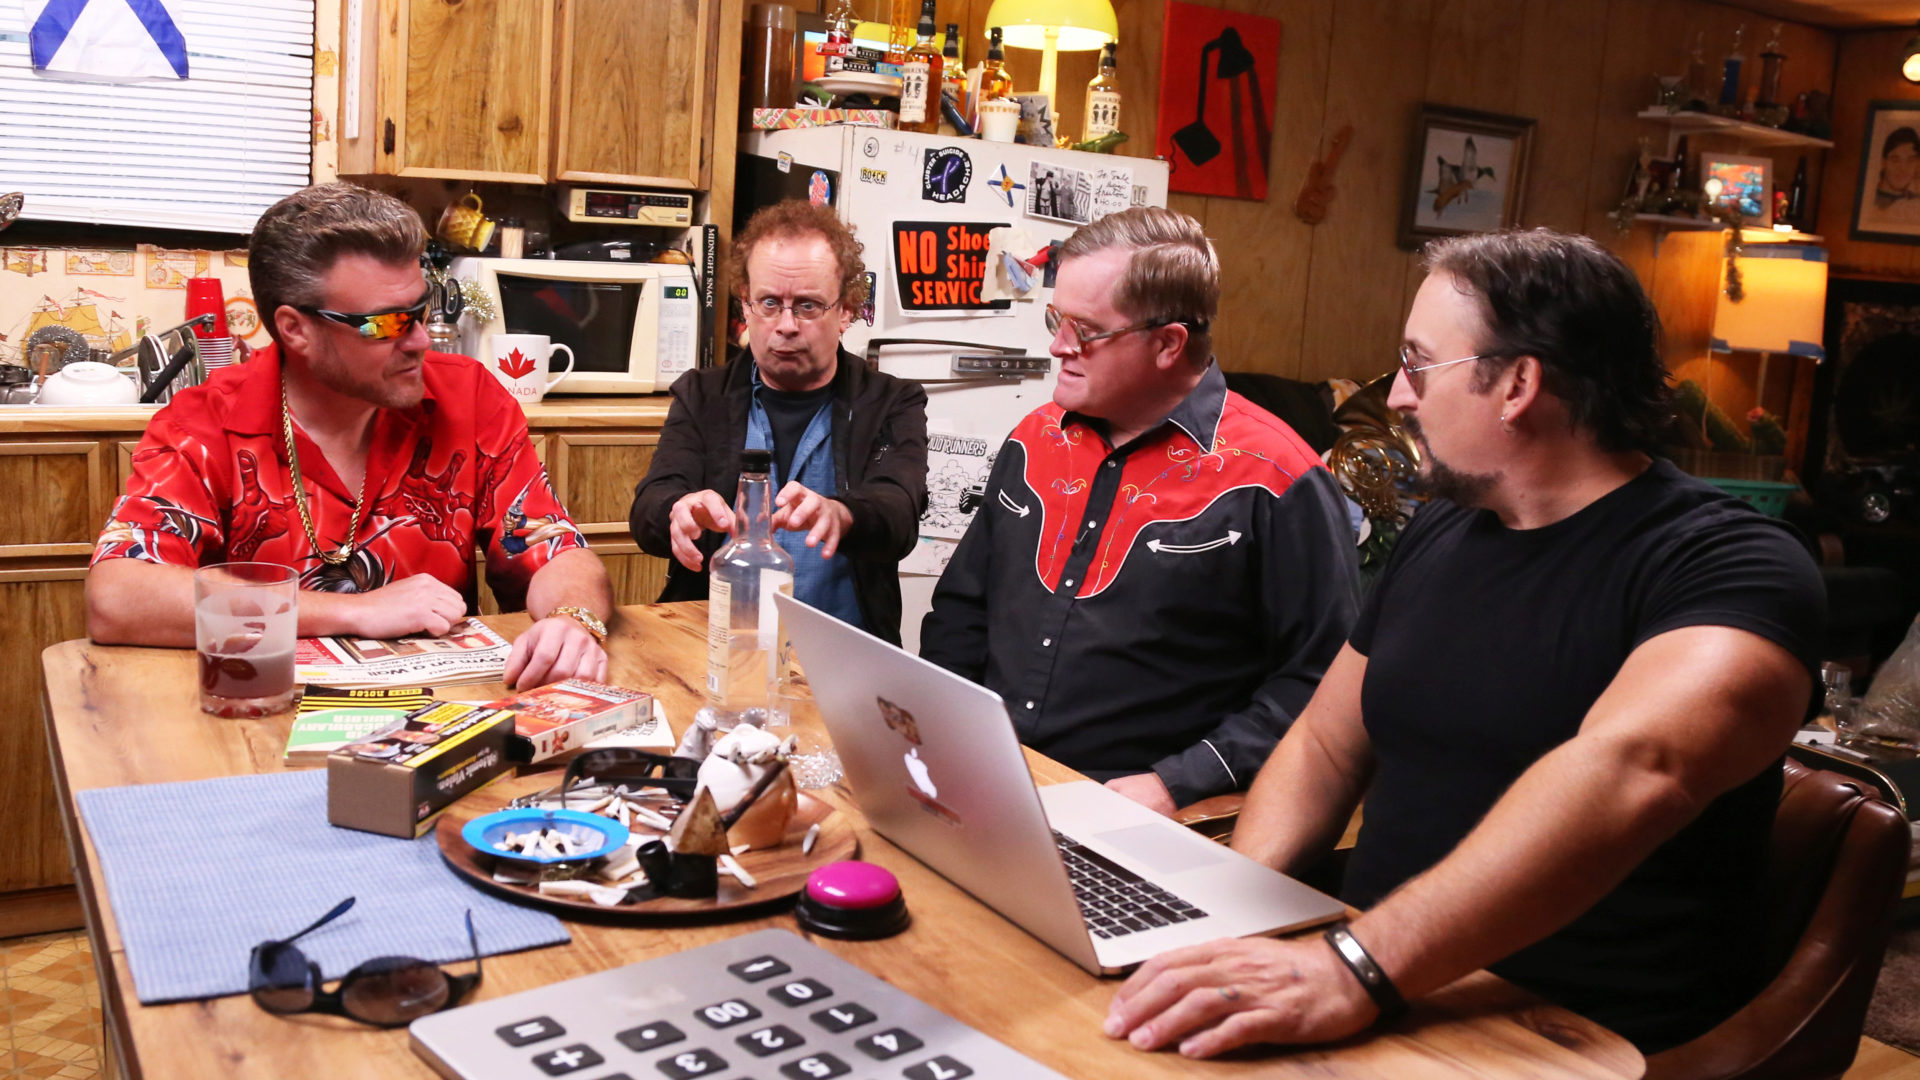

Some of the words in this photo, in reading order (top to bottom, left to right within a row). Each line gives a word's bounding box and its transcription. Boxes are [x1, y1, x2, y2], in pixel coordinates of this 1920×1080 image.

[938, 148, 964, 158] SUICIDE
[924, 157, 937, 189] CLUSTER
[932, 160, 971, 201] HEADACHE
[946, 225, 990, 250] Shoe
[706, 228, 715, 276] MIDNIGHT
[899, 230, 938, 275] NO
[946, 253, 986, 279] Shir
[706, 277, 714, 307] SNACK
[911, 281, 991, 305] SERVIC
[508, 387, 537, 396] NADA
[944, 438, 987, 456] RUNNERS
[367, 668, 409, 677] Wall
[297, 723, 385, 732] OCABULARY
[332, 714, 395, 723] BUILDER
[785, 982, 813, 999] 0
[704, 1000, 749, 1023] 00
[829, 1007, 855, 1024] 1
[750, 1030, 784, 1048] 2
[872, 1034, 898, 1052] 4
[675, 1053, 707, 1073] 3
[799, 1057, 832, 1077] 5
[927, 1060, 957, 1080] 7
